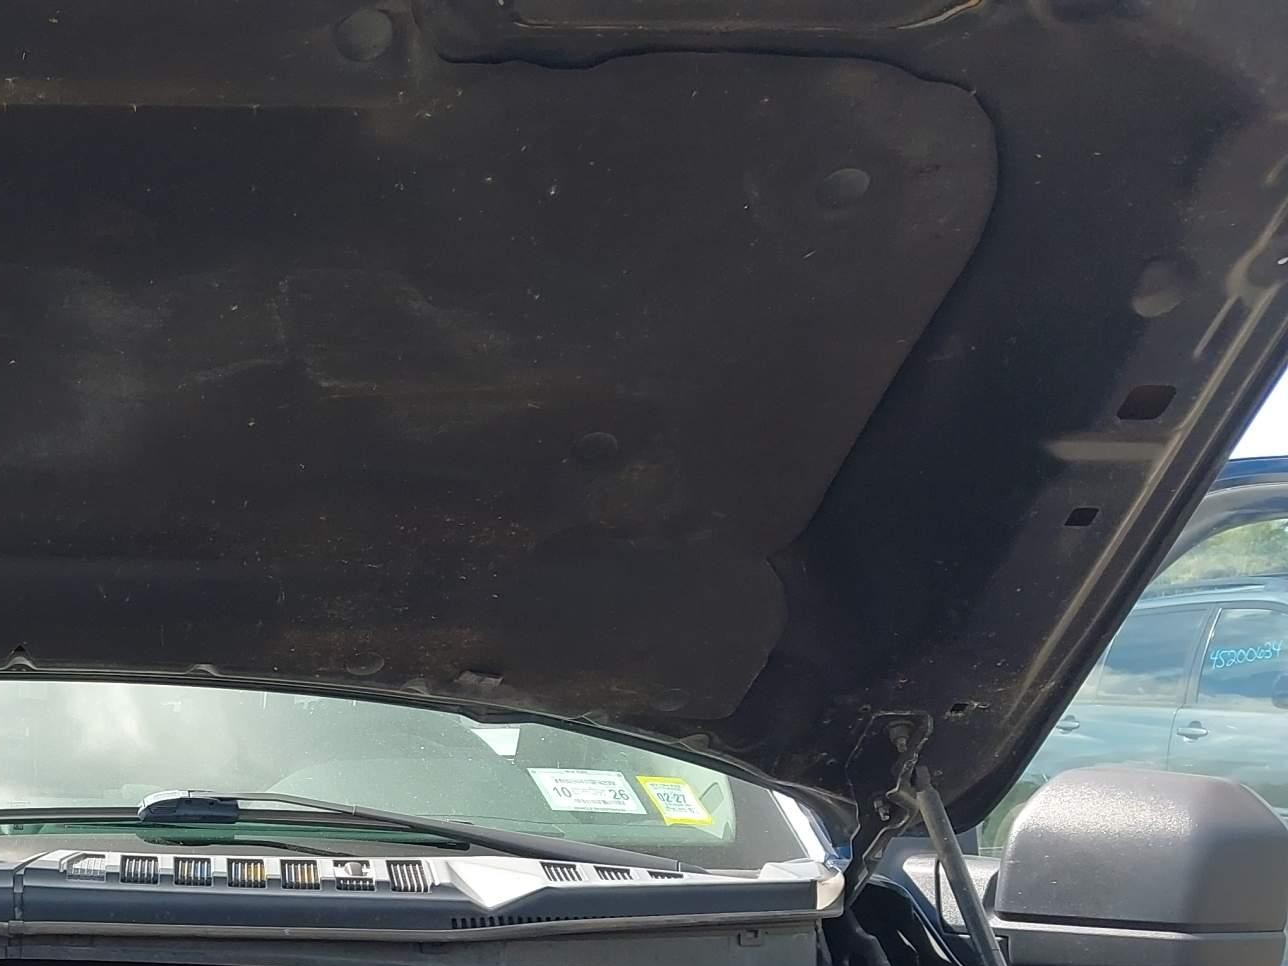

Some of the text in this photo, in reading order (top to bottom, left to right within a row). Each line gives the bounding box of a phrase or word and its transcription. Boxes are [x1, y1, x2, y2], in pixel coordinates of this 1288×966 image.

[1210, 640, 1284, 669] 45200634
[553, 786, 573, 798] 10
[608, 788, 630, 801] 26
